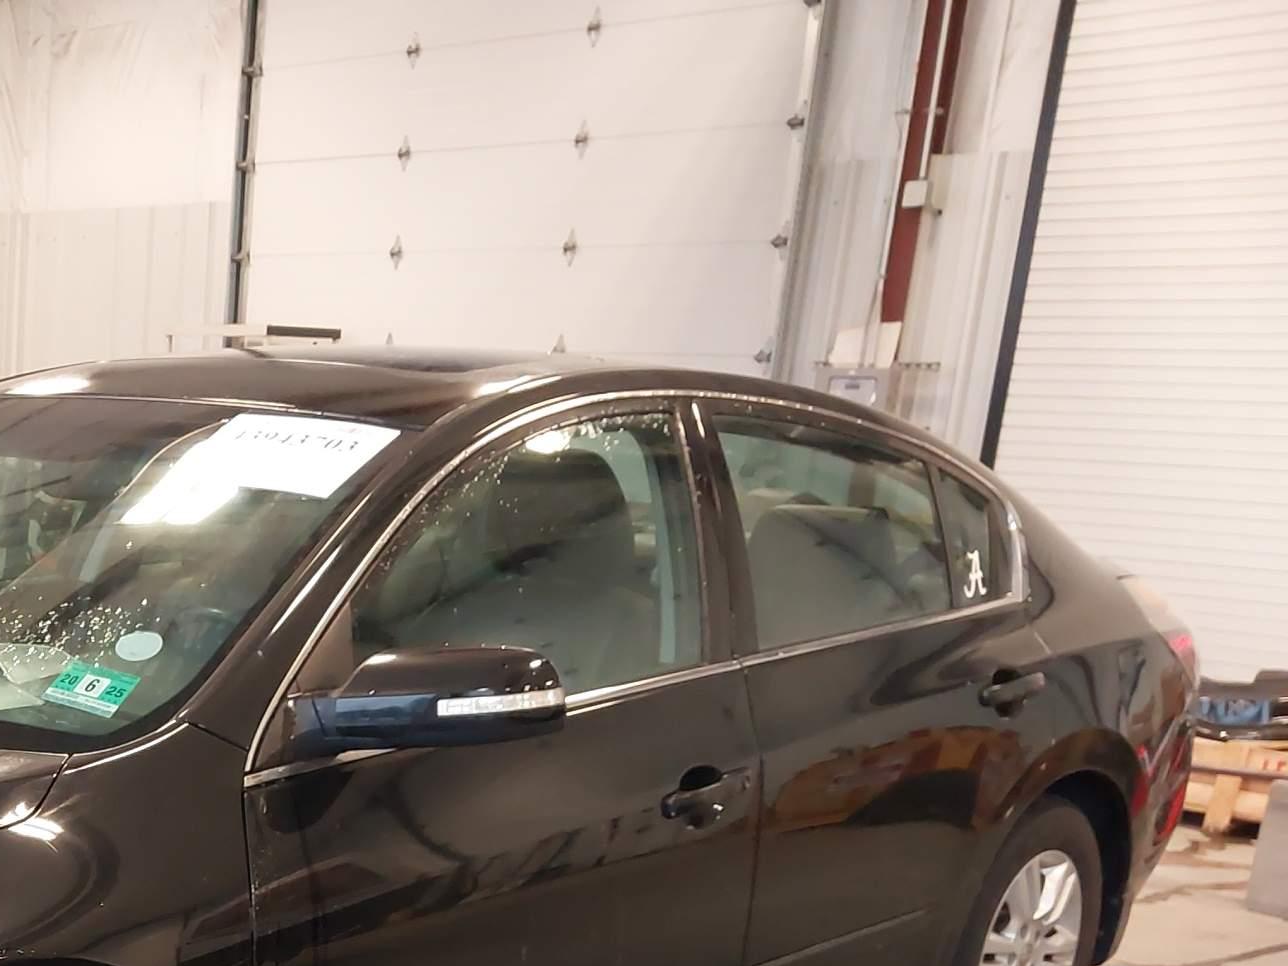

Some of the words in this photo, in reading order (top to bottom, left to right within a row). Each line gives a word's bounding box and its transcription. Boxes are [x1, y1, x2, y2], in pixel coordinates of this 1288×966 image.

[60, 673, 79, 686] 20
[84, 678, 100, 692] 6
[105, 685, 127, 698] 25
